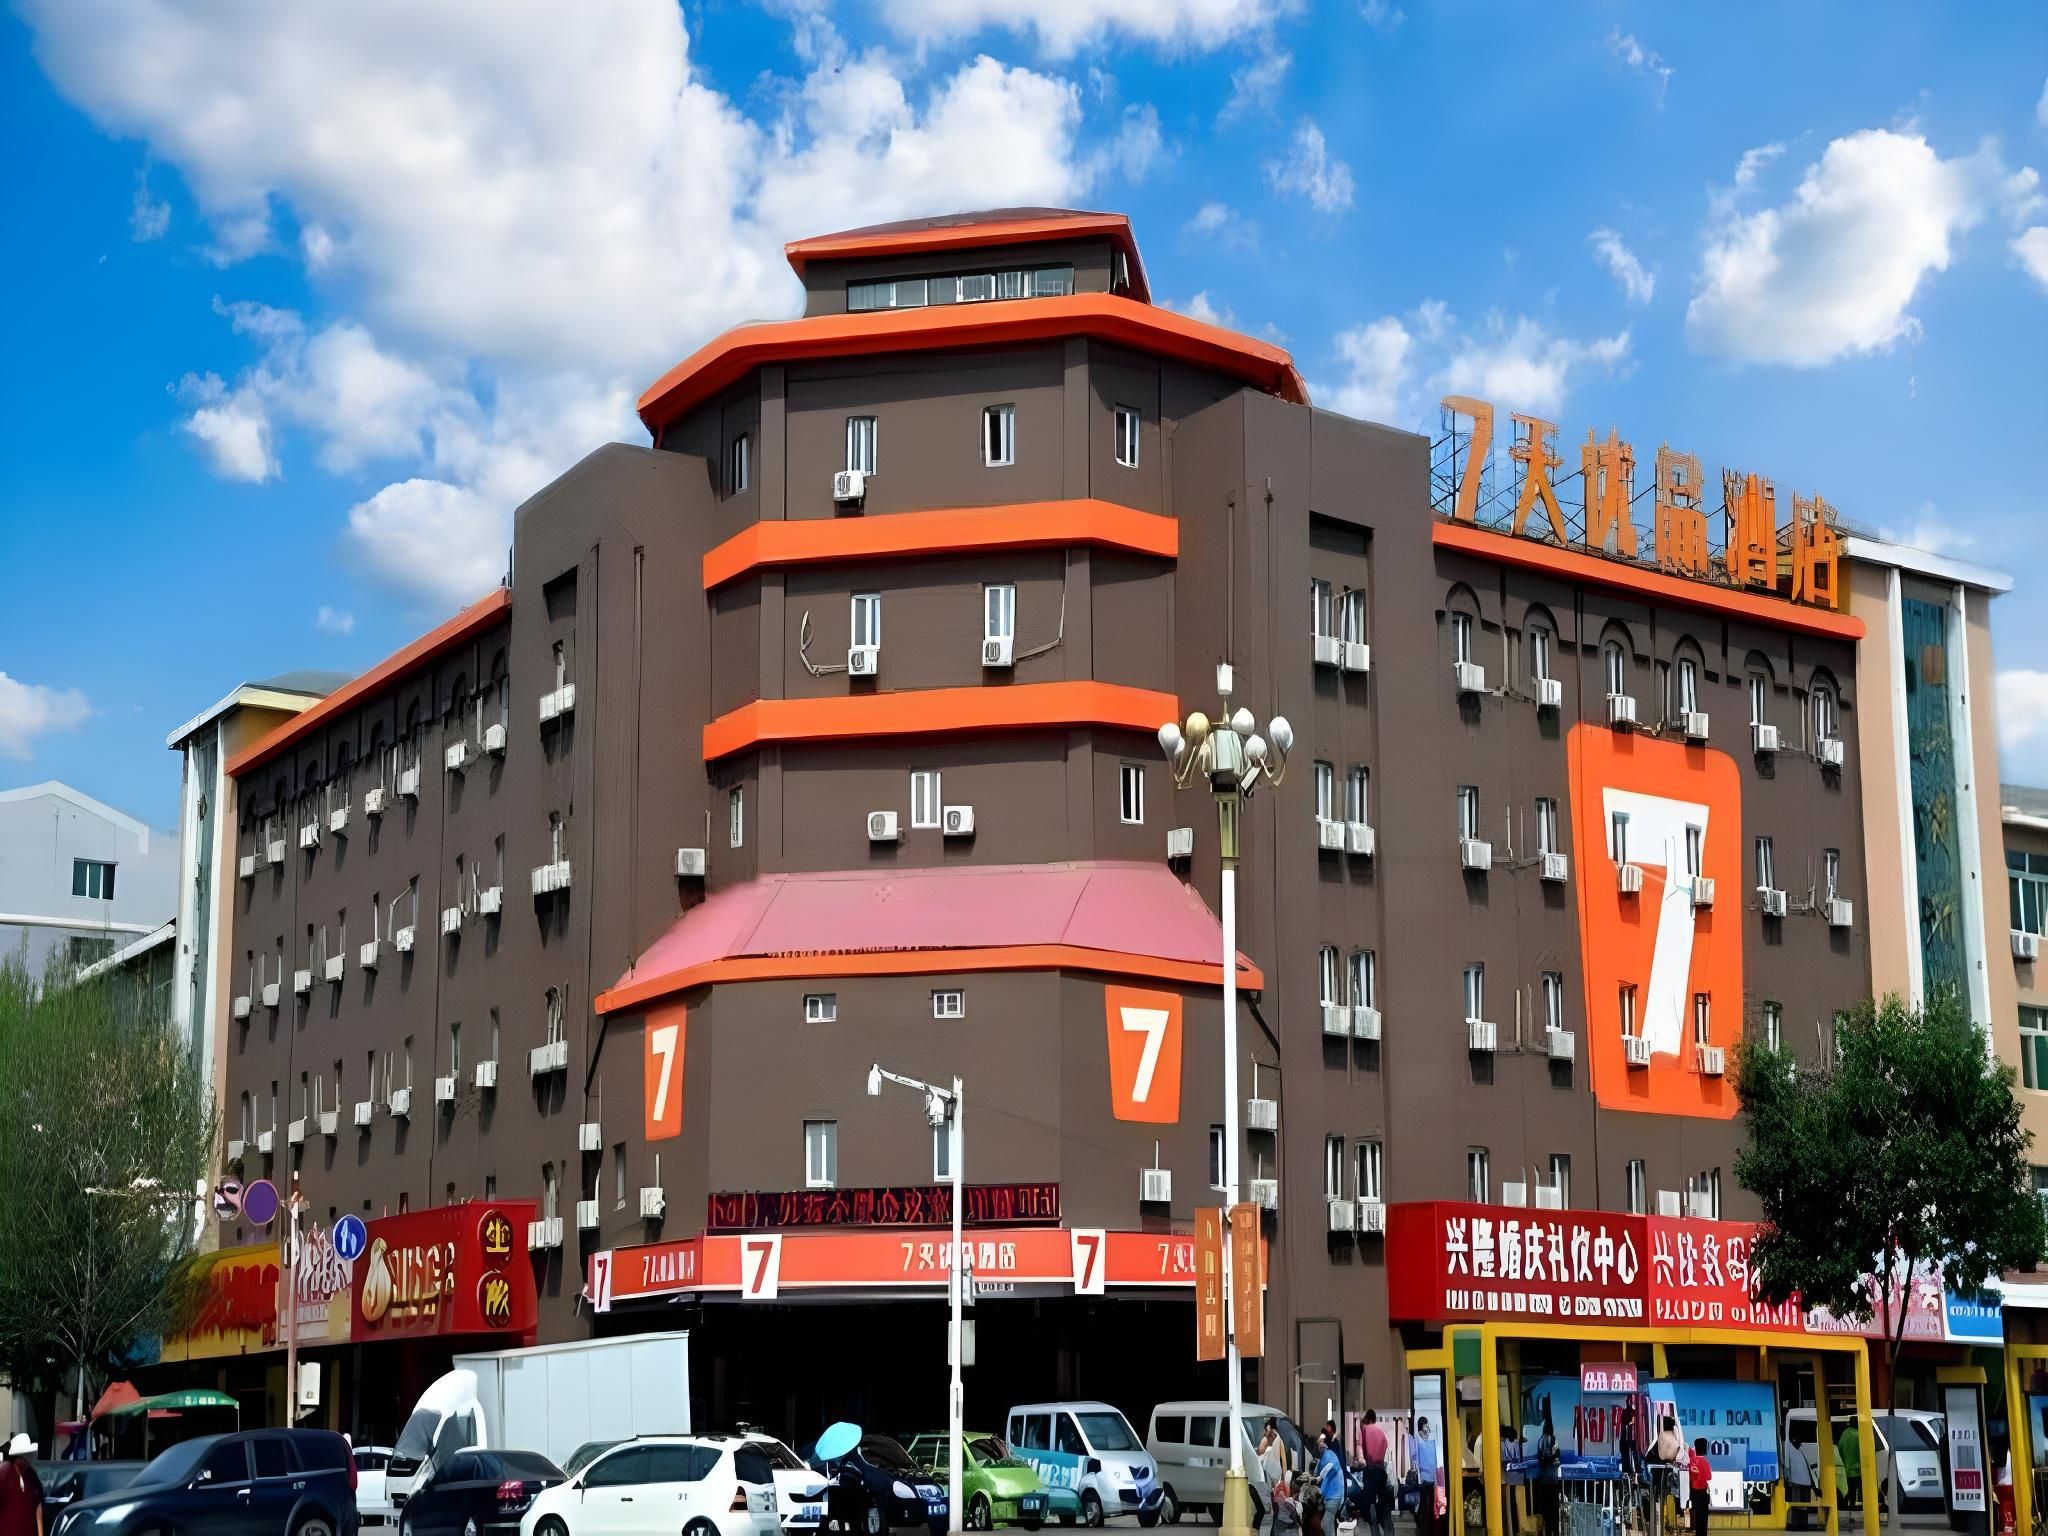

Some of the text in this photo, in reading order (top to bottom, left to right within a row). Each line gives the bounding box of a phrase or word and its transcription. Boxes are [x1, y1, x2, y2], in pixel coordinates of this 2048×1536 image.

[1602, 787, 1710, 1057] 7
[651, 1024, 679, 1121] 7
[1119, 1006, 1170, 1104] 7
[597, 1258, 608, 1309] 7
[747, 1241, 774, 1294] 7
[1077, 1235, 1100, 1289] 7
